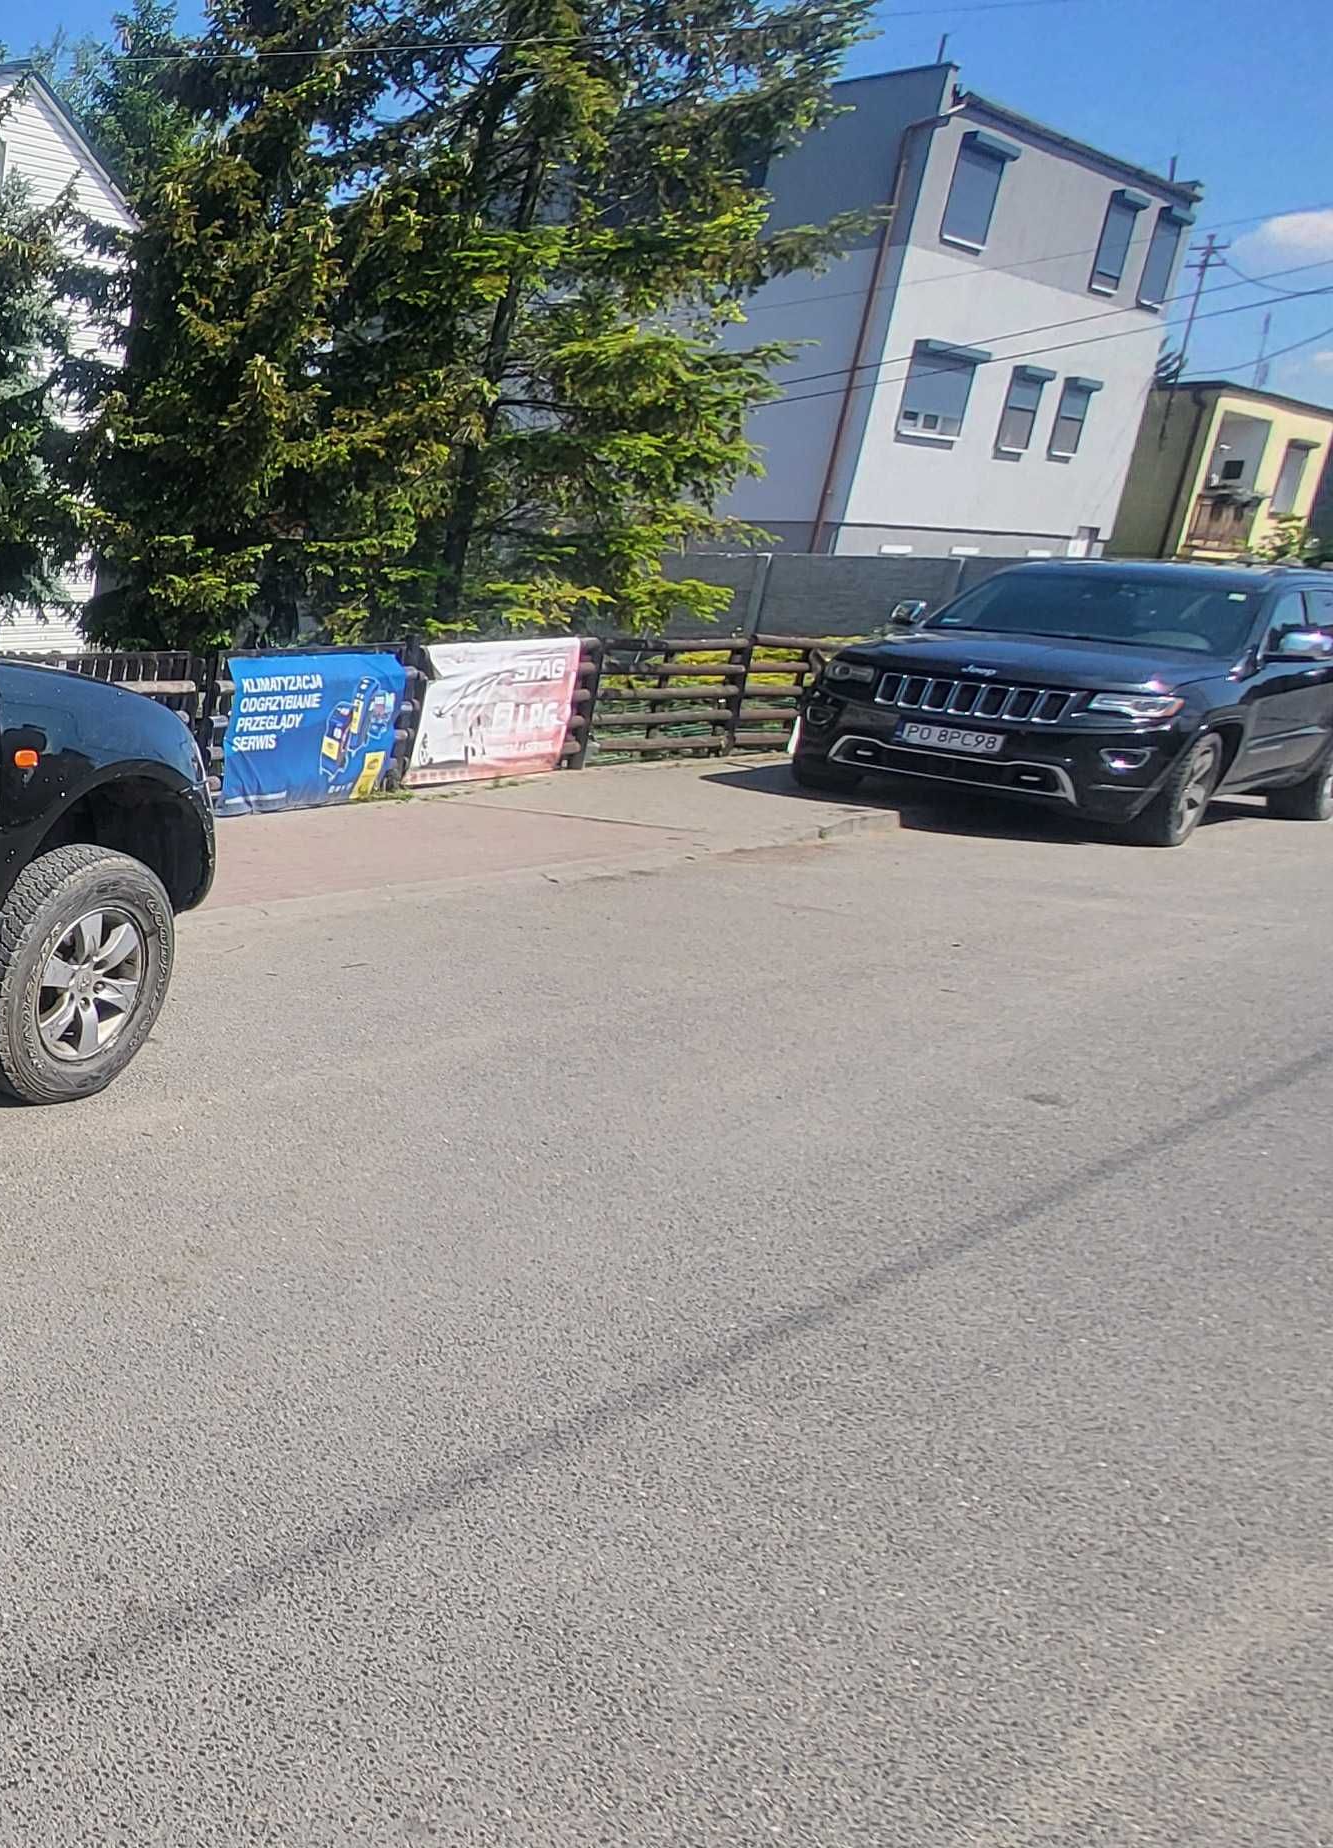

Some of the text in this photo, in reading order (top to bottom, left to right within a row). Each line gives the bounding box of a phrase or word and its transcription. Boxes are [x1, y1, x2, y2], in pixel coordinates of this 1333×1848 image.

[241, 674, 323, 694] KLIMATYZACJA
[240, 693, 322, 713] ODGRZYBIANIE
[236, 713, 303, 733] PRZEGLĄDY
[231, 734, 277, 752] SERWIS
[906, 725, 997, 749] PO 8PC98
